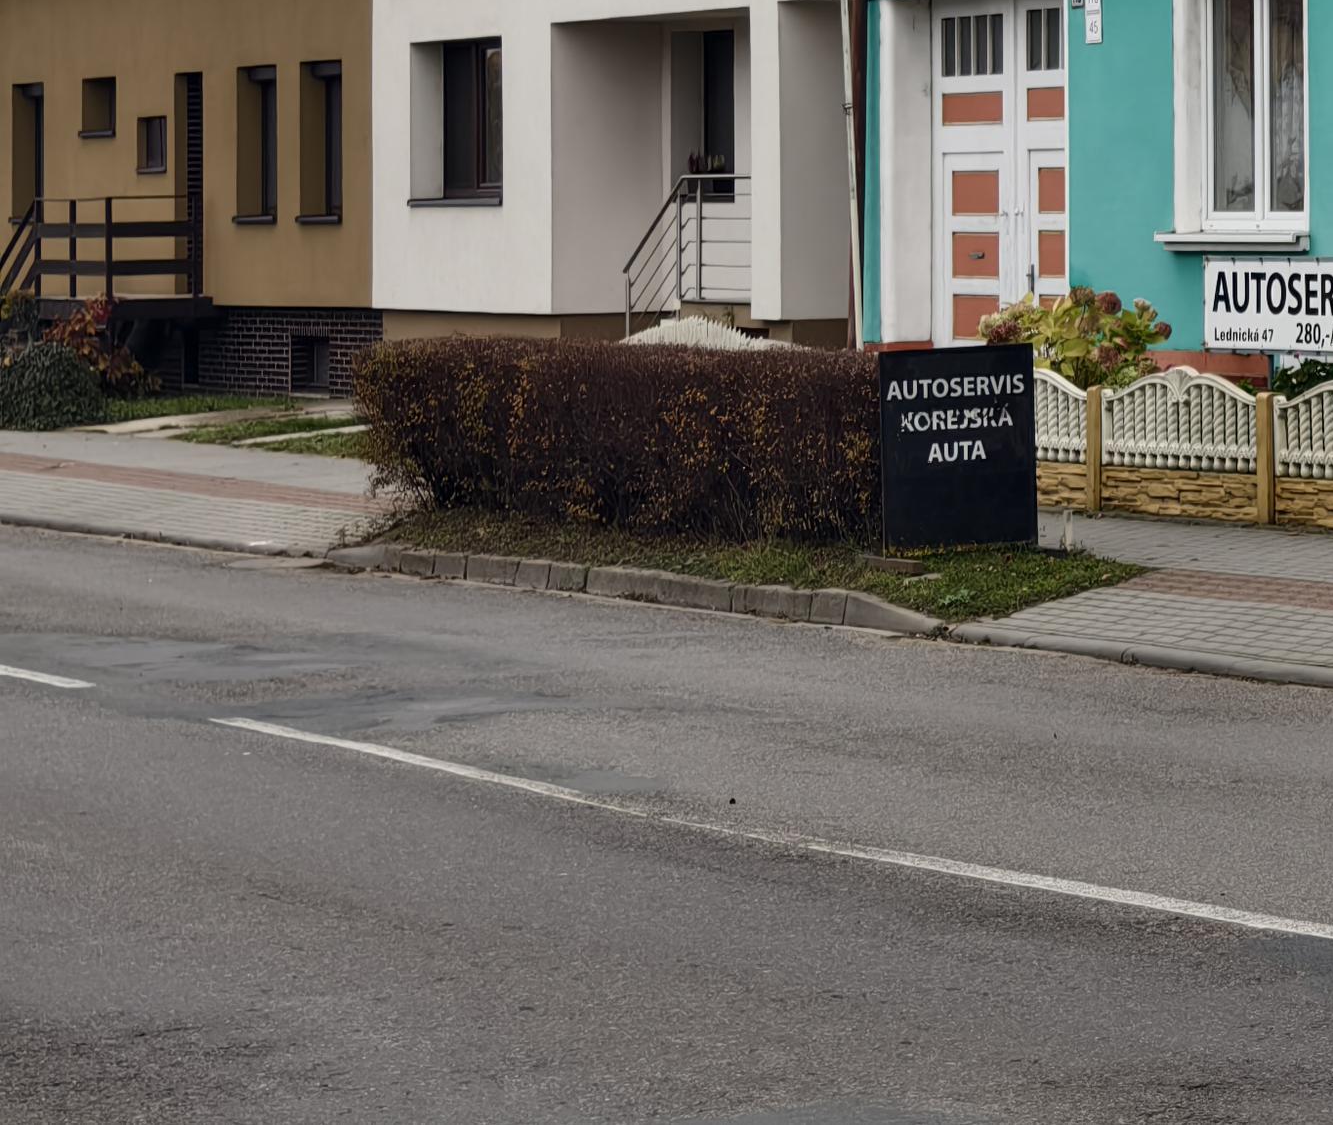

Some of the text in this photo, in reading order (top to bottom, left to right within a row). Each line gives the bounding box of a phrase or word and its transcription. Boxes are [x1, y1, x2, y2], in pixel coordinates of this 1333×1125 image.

[1089, 20, 1099, 35] 45
[1214, 327, 1274, 343] Lednická 47
[886, 374, 1025, 402] AUTOSERVIS
[928, 440, 987, 464] AUTA
